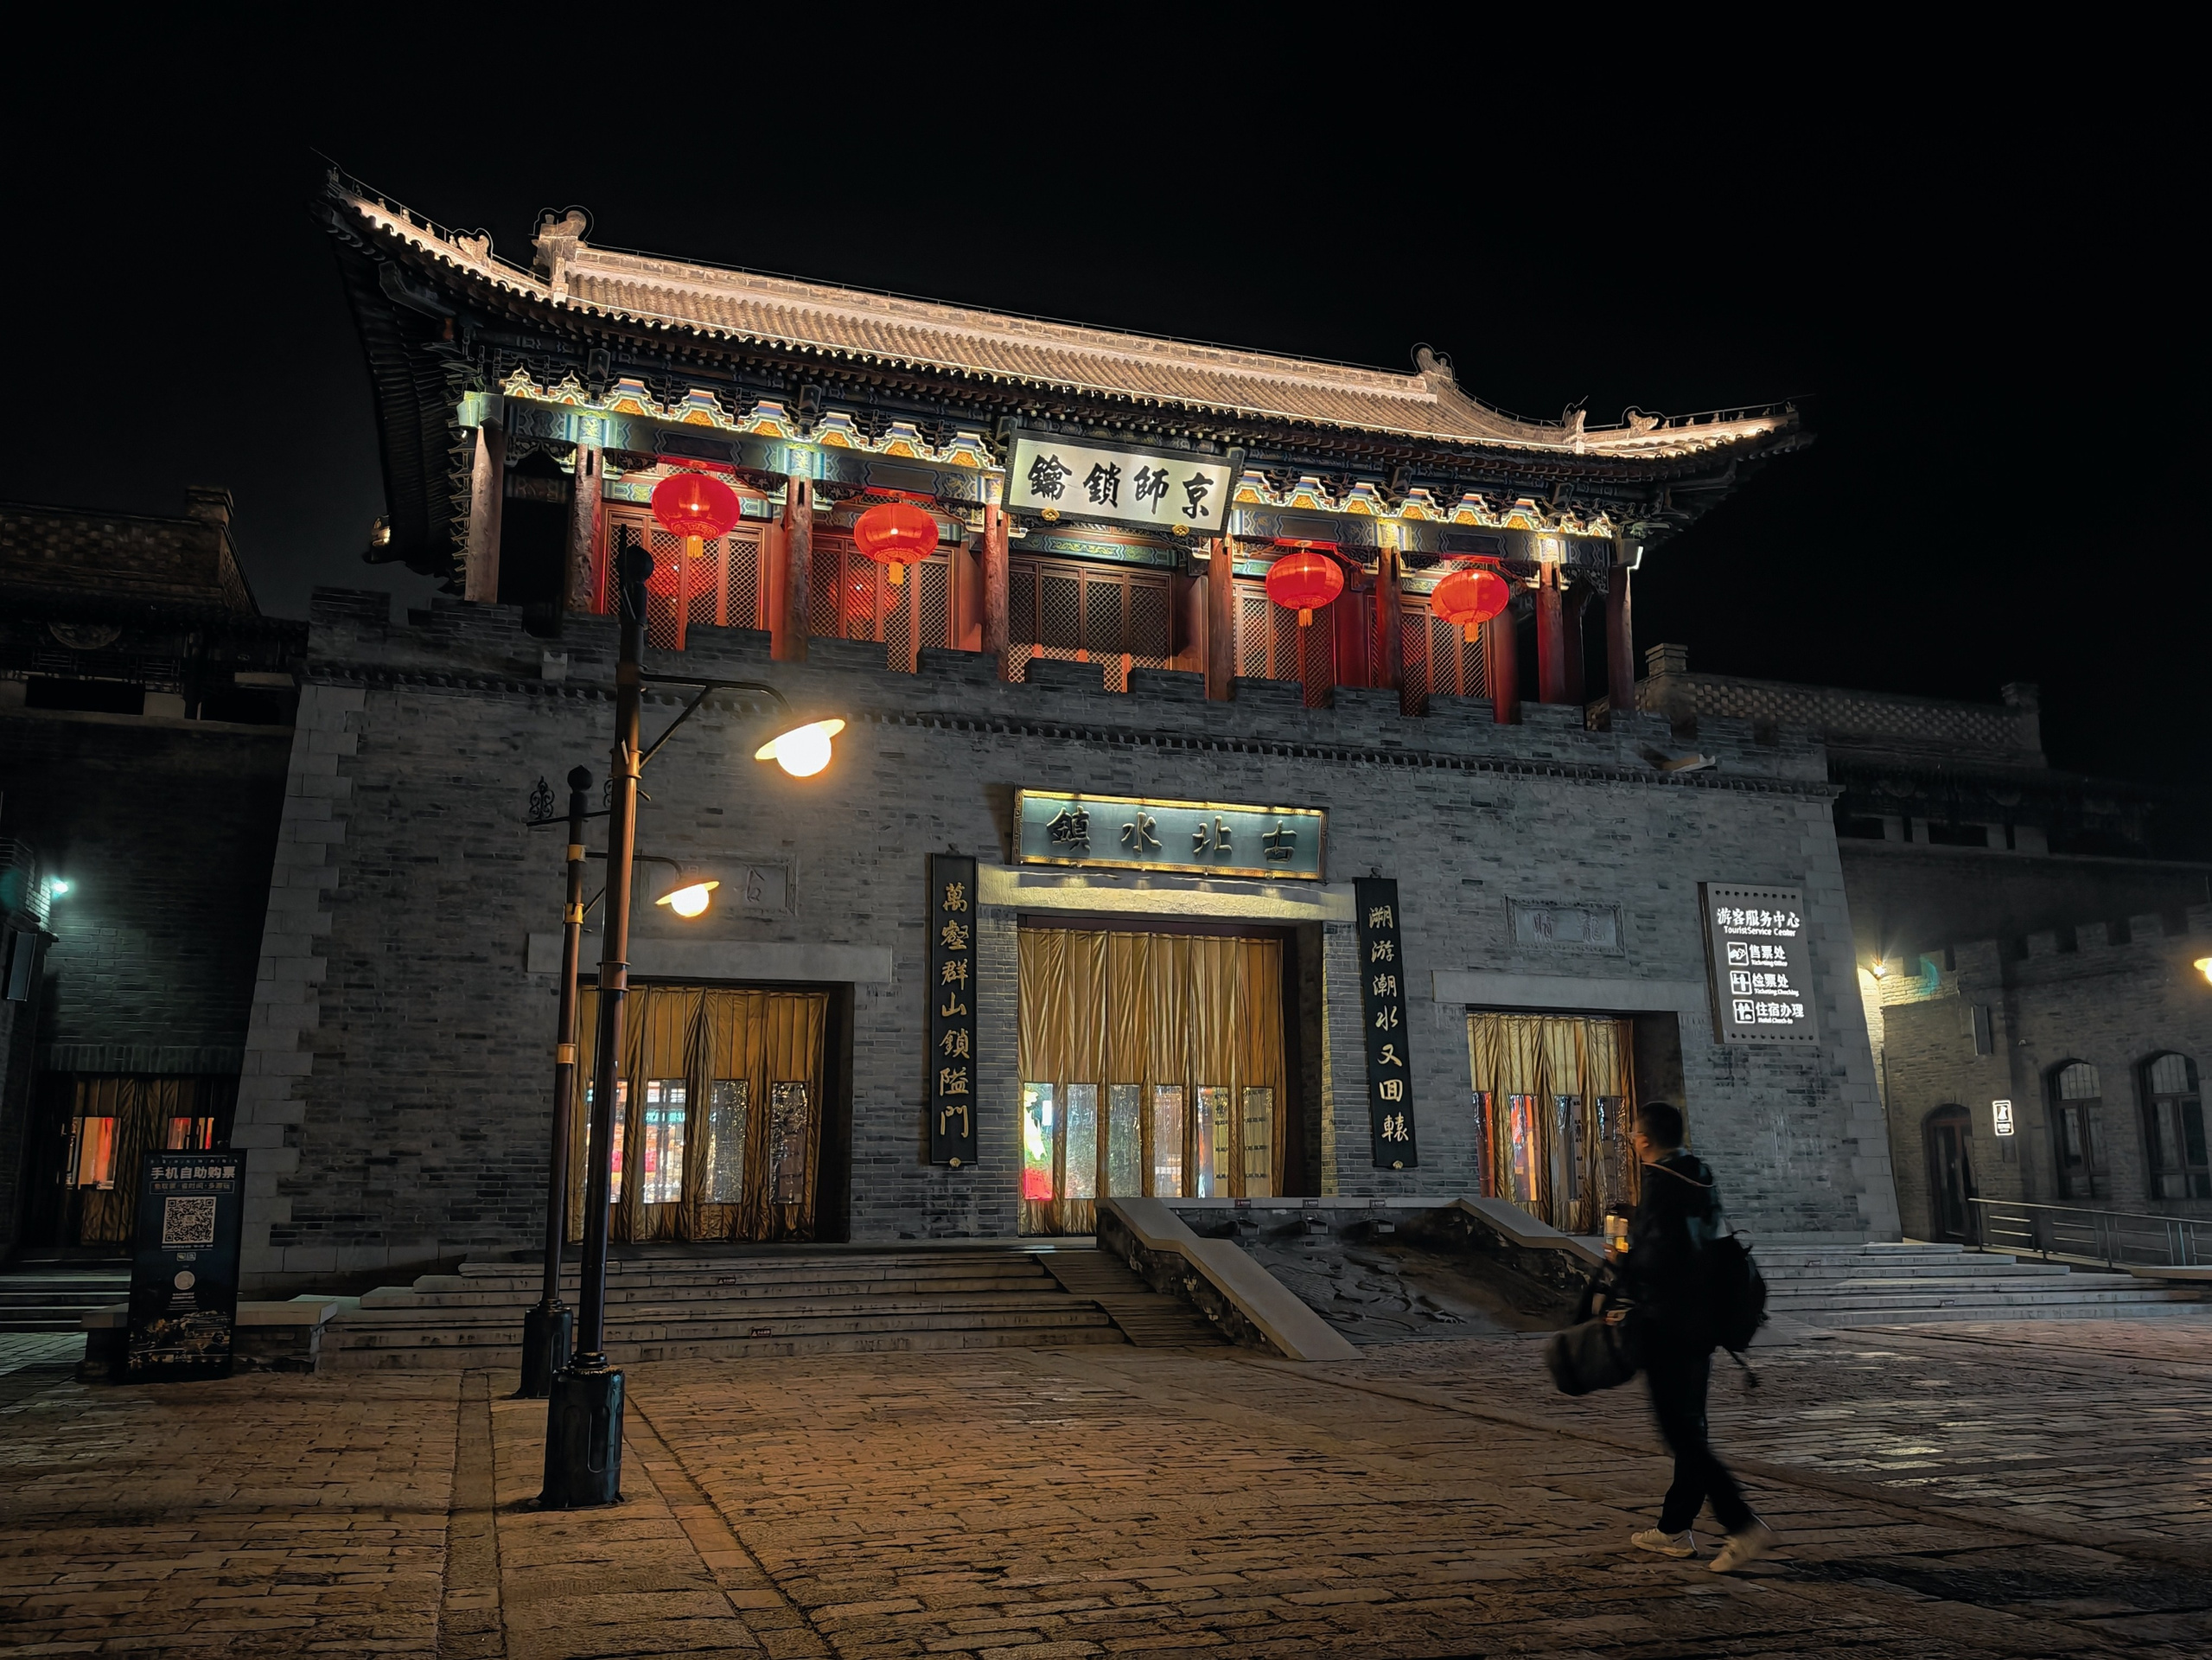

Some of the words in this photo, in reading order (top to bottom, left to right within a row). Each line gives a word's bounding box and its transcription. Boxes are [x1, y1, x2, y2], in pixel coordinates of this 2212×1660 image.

[1717, 907, 1801, 928] 游客服务中心
[1749, 945, 1786, 959] 售票处
[1752, 973, 1789, 988] 检票处
[1756, 1002, 1805, 1018] 住宿办理
[150, 1165, 236, 1180] 手机自助购票
